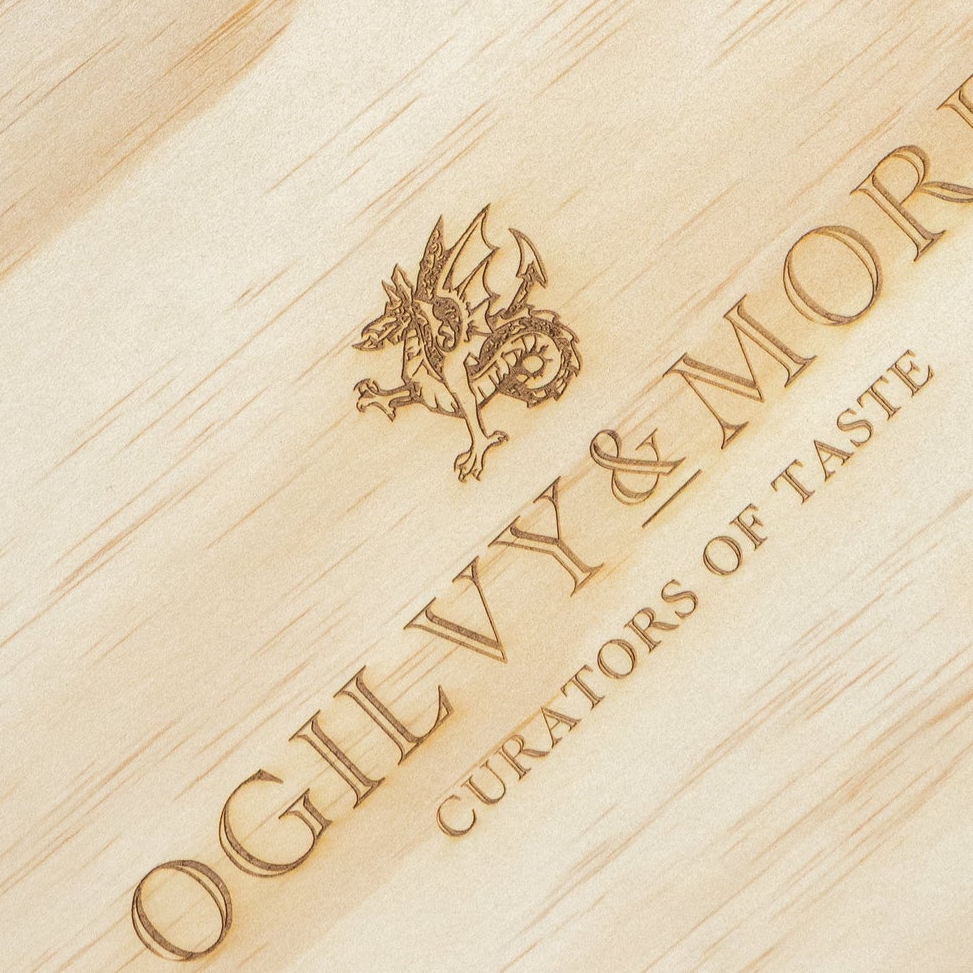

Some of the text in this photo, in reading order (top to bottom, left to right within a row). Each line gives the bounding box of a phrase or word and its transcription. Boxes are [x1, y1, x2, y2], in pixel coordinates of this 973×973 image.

[130, 475, 605, 962] OGILVY
[589, 428, 689, 509] &
[435, 349, 935, 839] CURATORS OF TASTE
